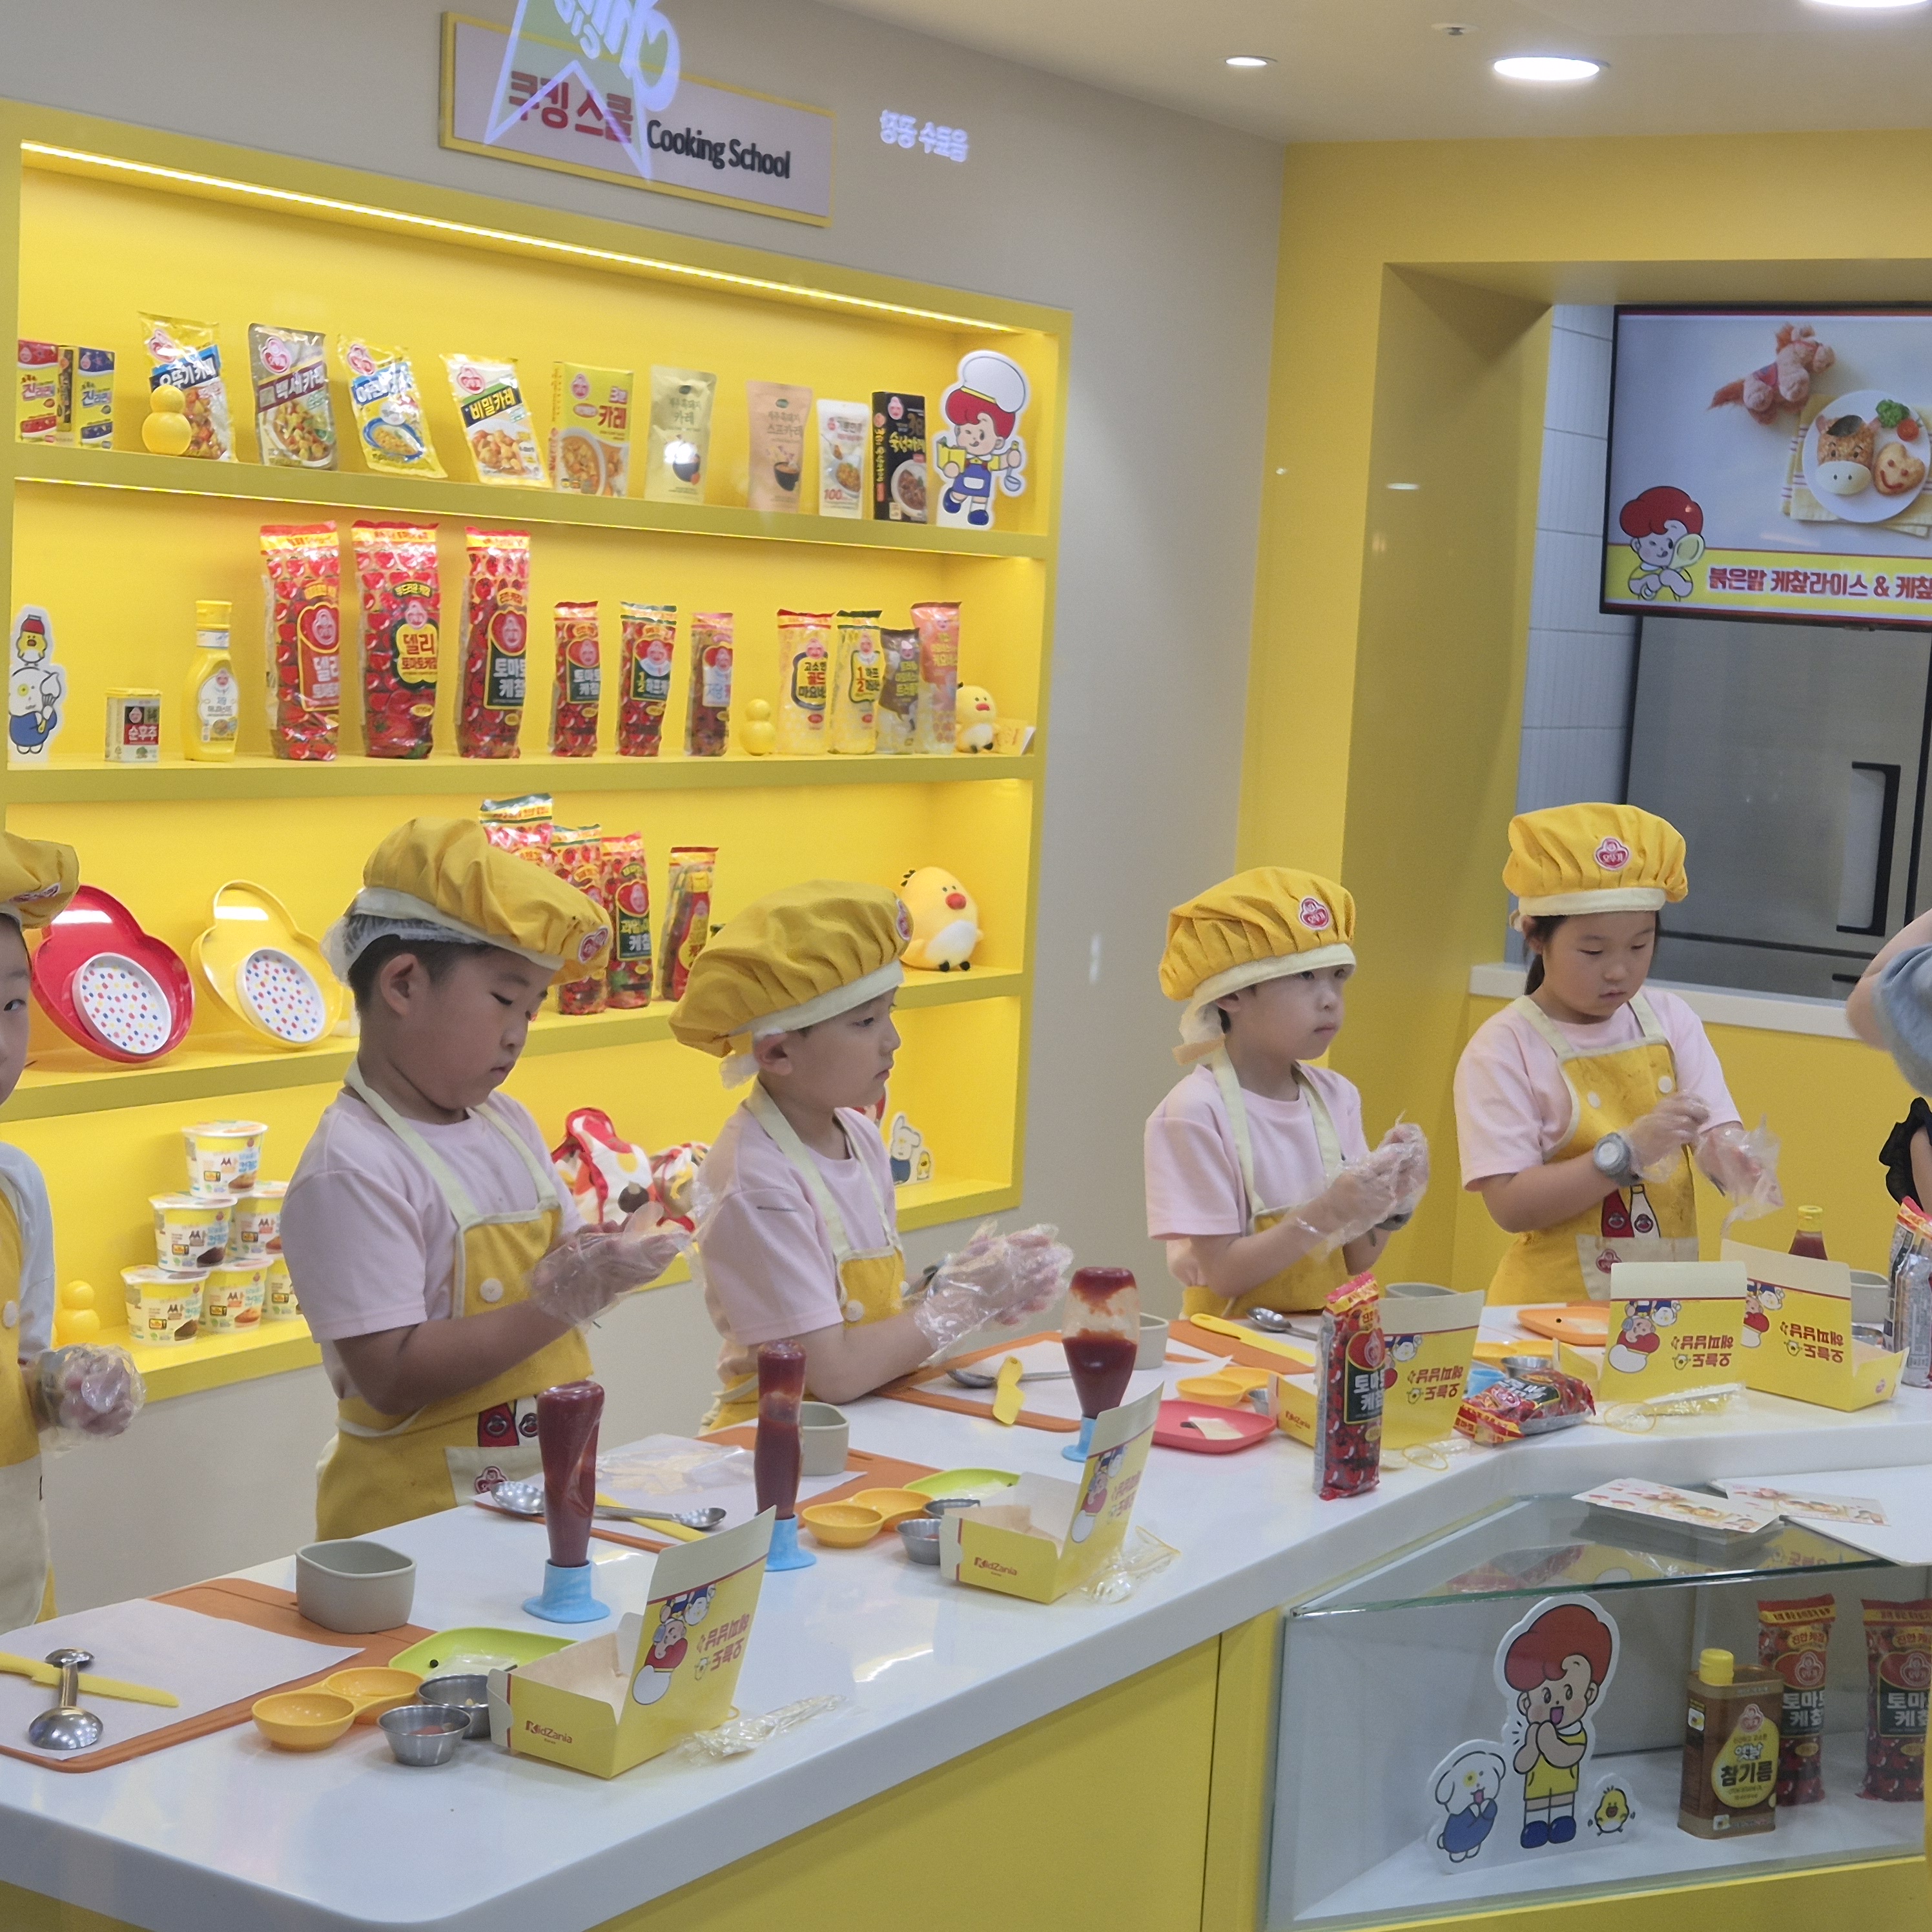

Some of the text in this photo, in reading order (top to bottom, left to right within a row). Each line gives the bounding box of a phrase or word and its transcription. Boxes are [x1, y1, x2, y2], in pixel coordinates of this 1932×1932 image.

[647, 119, 790, 179] Cooking School
[469, 387, 516, 420] 비밀카레
[597, 405, 627, 429] 카레
[1873, 575, 1890, 597] &
[403, 633, 435, 655] 델리
[1692, 1352, 1732, 1368] 오늘도
[1803, 1343, 1844, 1364] 오늘도
[1424, 1382, 1461, 1401] 오늘도
[974, 1556, 1018, 1576] KidZania
[710, 1638, 745, 1672] 오늘도
[525, 1720, 573, 1743] KidZania
[1734, 1741, 1763, 1762] 옛날
[1720, 1760, 1773, 1787] 참기름
